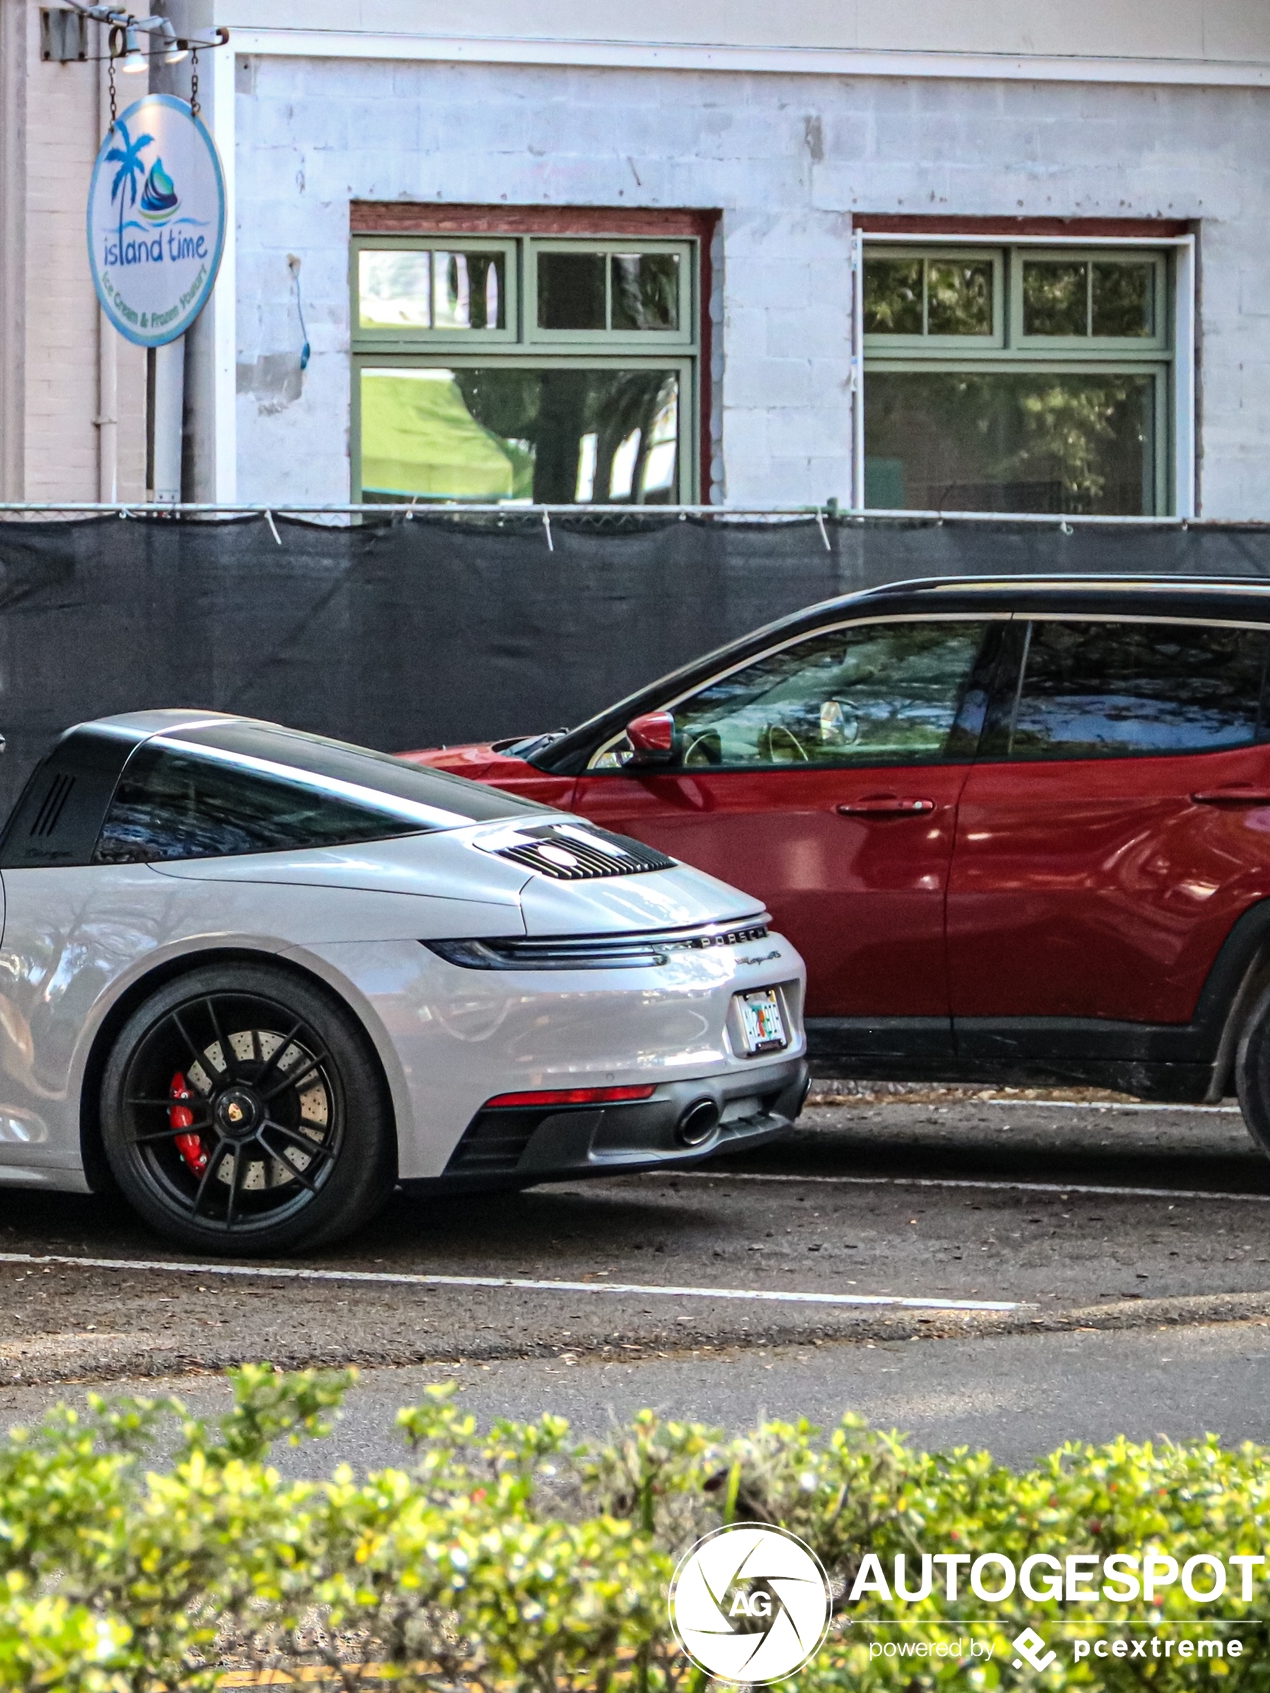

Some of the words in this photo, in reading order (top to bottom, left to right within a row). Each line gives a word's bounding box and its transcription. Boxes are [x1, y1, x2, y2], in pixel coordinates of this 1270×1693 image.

[104, 231, 163, 266] island
[167, 230, 208, 263] time
[101, 270, 115, 296] Ice
[114, 291, 139, 326] Cream
[140, 311, 149, 328] &
[150, 305, 179, 328] Frozen
[700, 926, 768, 949] PORSCH
